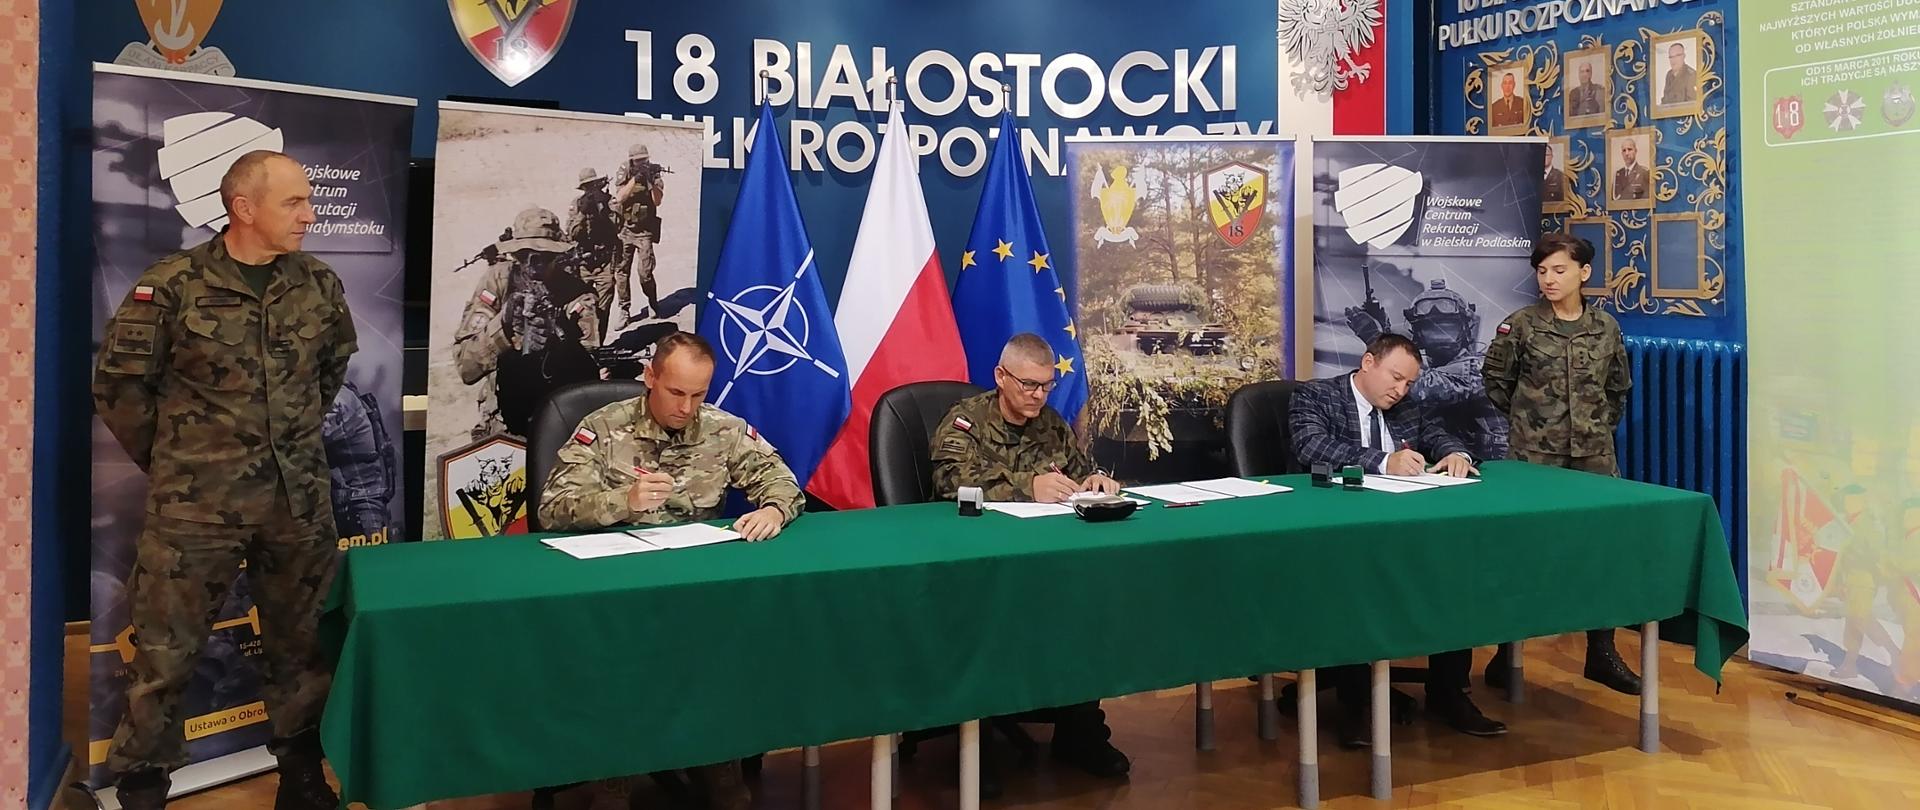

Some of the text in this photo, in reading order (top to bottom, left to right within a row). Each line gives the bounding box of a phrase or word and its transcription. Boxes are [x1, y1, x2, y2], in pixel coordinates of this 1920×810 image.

[1759, 11, 1836, 32] NAJWYŻSZYCH
[1791, 9, 1920, 40] KTÓRYCH POLSKA WYM
[1439, 12, 1503, 50] PUŁKU
[1795, 44, 1811, 54] OD
[1814, 33, 1875, 51] WŁASNYCH
[1834, 60, 1870, 72] MARCA
[1871, 55, 1890, 67] 2011
[625, 30, 1236, 119] 18 BIAŁOSTOCKI
[1801, 76, 1818, 86] ICH
[1820, 69, 1872, 84] TRADYCJE
[1874, 66, 1887, 77] SĄ
[303, 164, 361, 180] ojskowe
[311, 184, 348, 198] trum
[311, 202, 358, 219] rutacji
[1426, 195, 1482, 209] Wojskowe
[1424, 209, 1472, 220] Centrum
[306, 219, 385, 236] iałymstoku
[1228, 225, 1244, 238] 18
[1422, 223, 1480, 235] Rekrutacji
[1421, 236, 1531, 248] w Bielsku Podlaskim
[337, 526, 389, 551] em.pl
[189, 706, 266, 733] Ustawa o Obro
